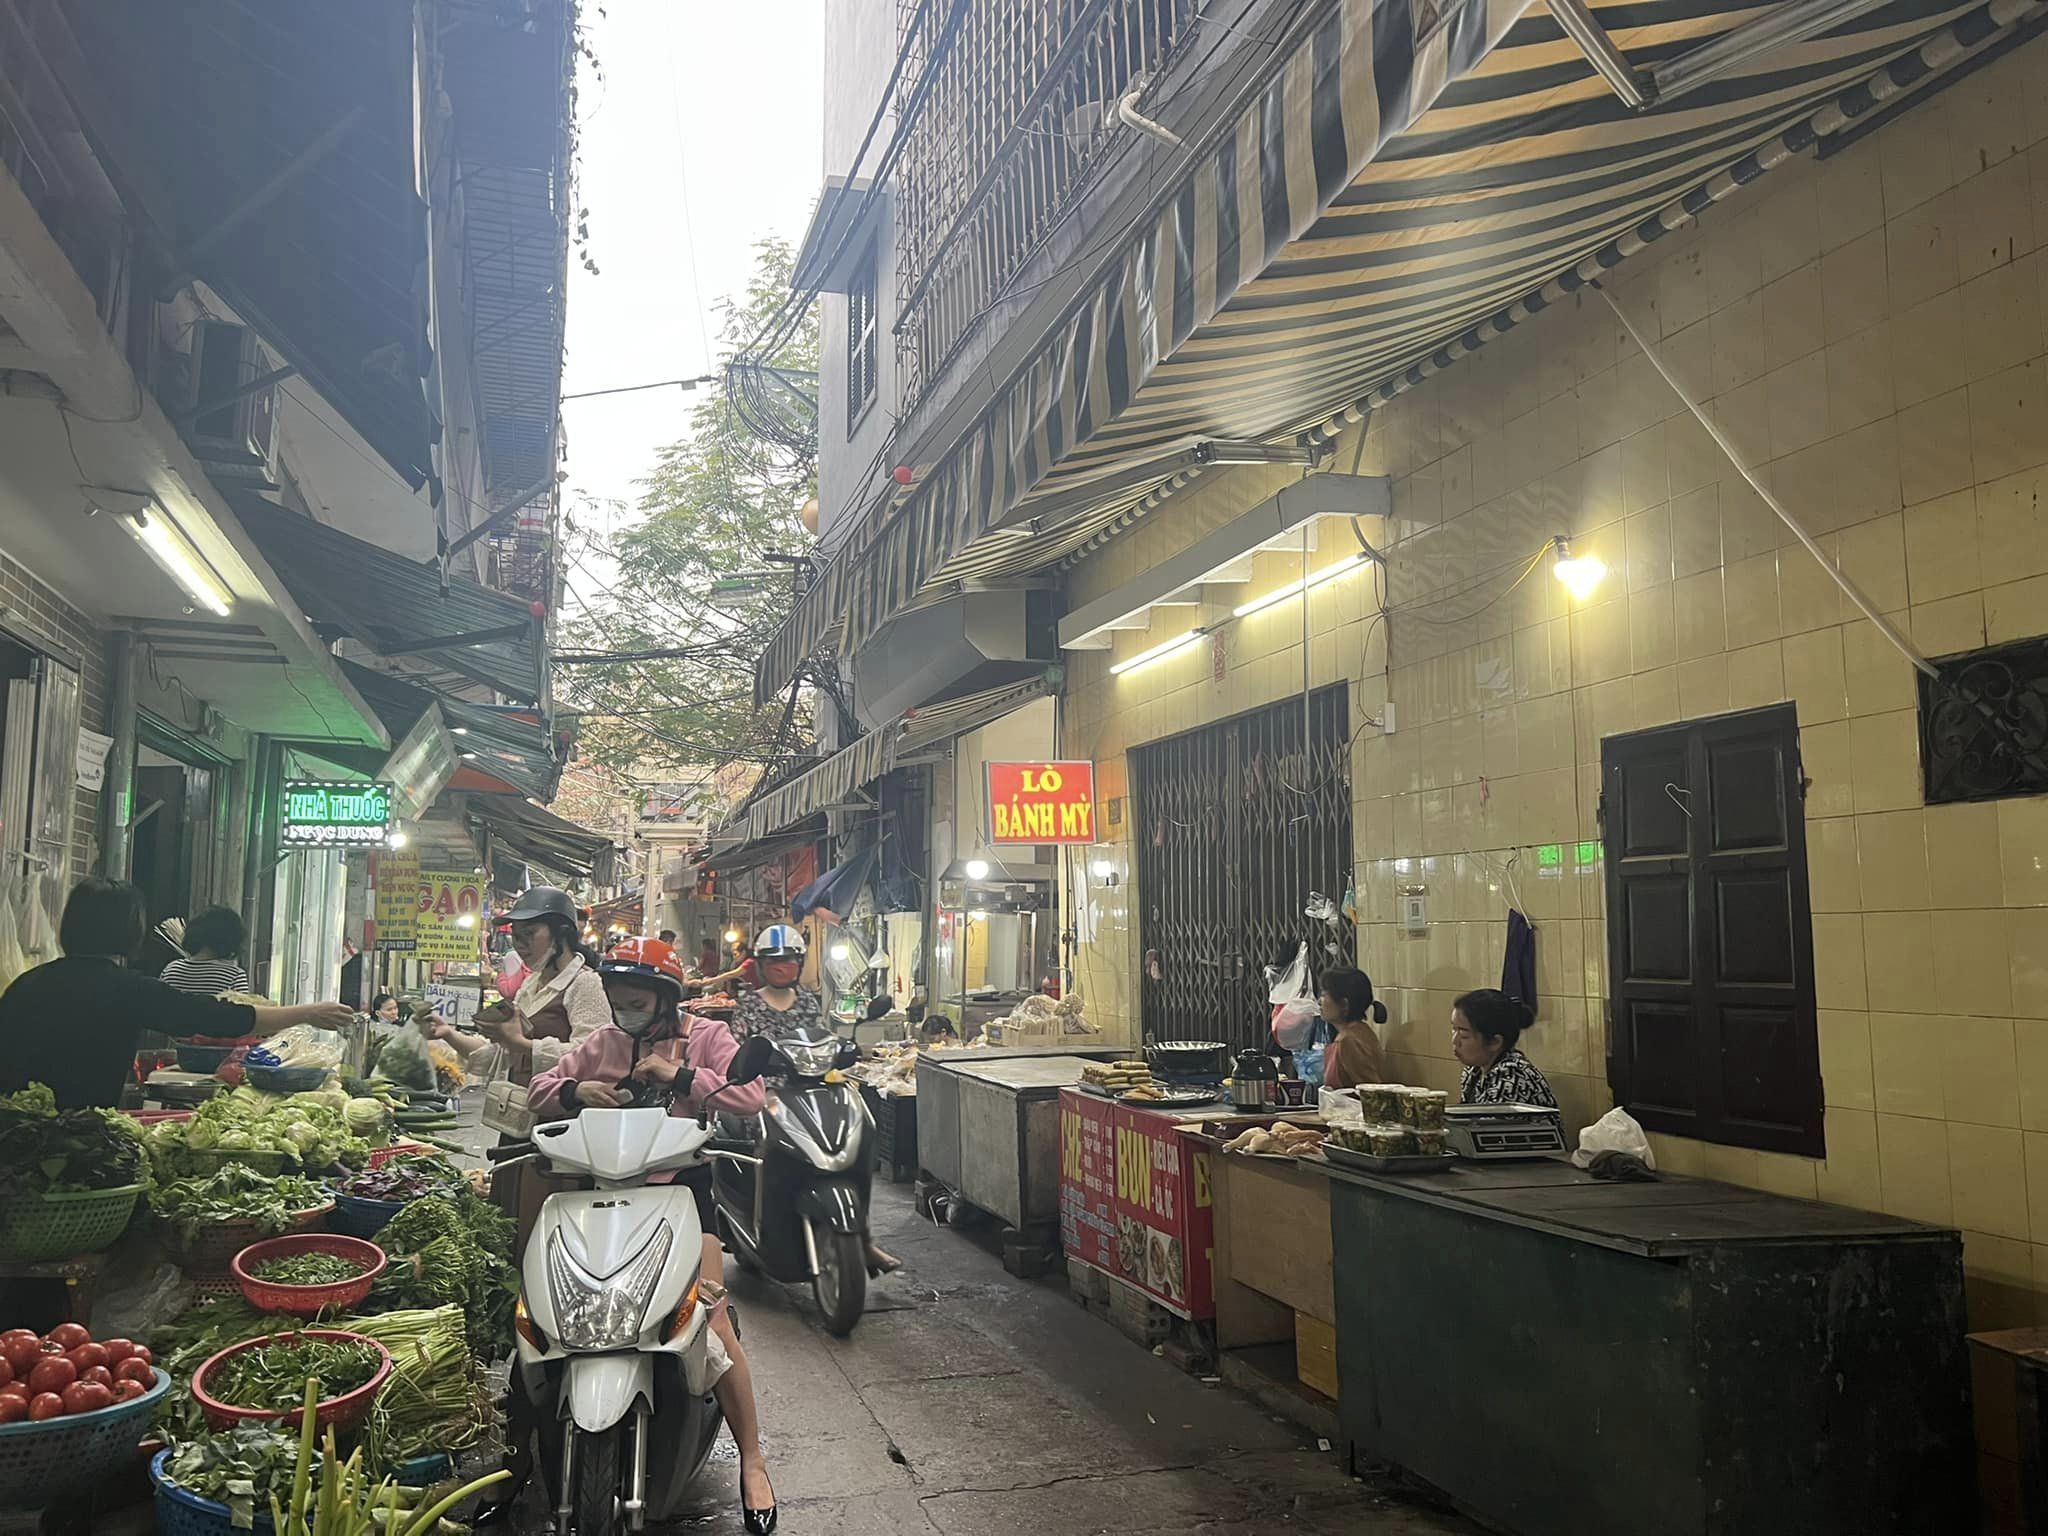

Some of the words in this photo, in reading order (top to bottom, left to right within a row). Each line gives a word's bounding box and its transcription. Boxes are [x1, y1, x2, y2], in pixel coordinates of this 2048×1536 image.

[1021, 764, 1063, 793] LÒ
[290, 789, 328, 820] NHÀ
[329, 787, 385, 821] THUỐC
[994, 793, 1055, 838] BÁNH
[1059, 792, 1091, 837] MỲ
[417, 882, 480, 922] GẠO
[432, 998, 458, 1017] 40
[1060, 1099, 1082, 1183] CHÈ
[1117, 1114, 1152, 1211] BÚN
